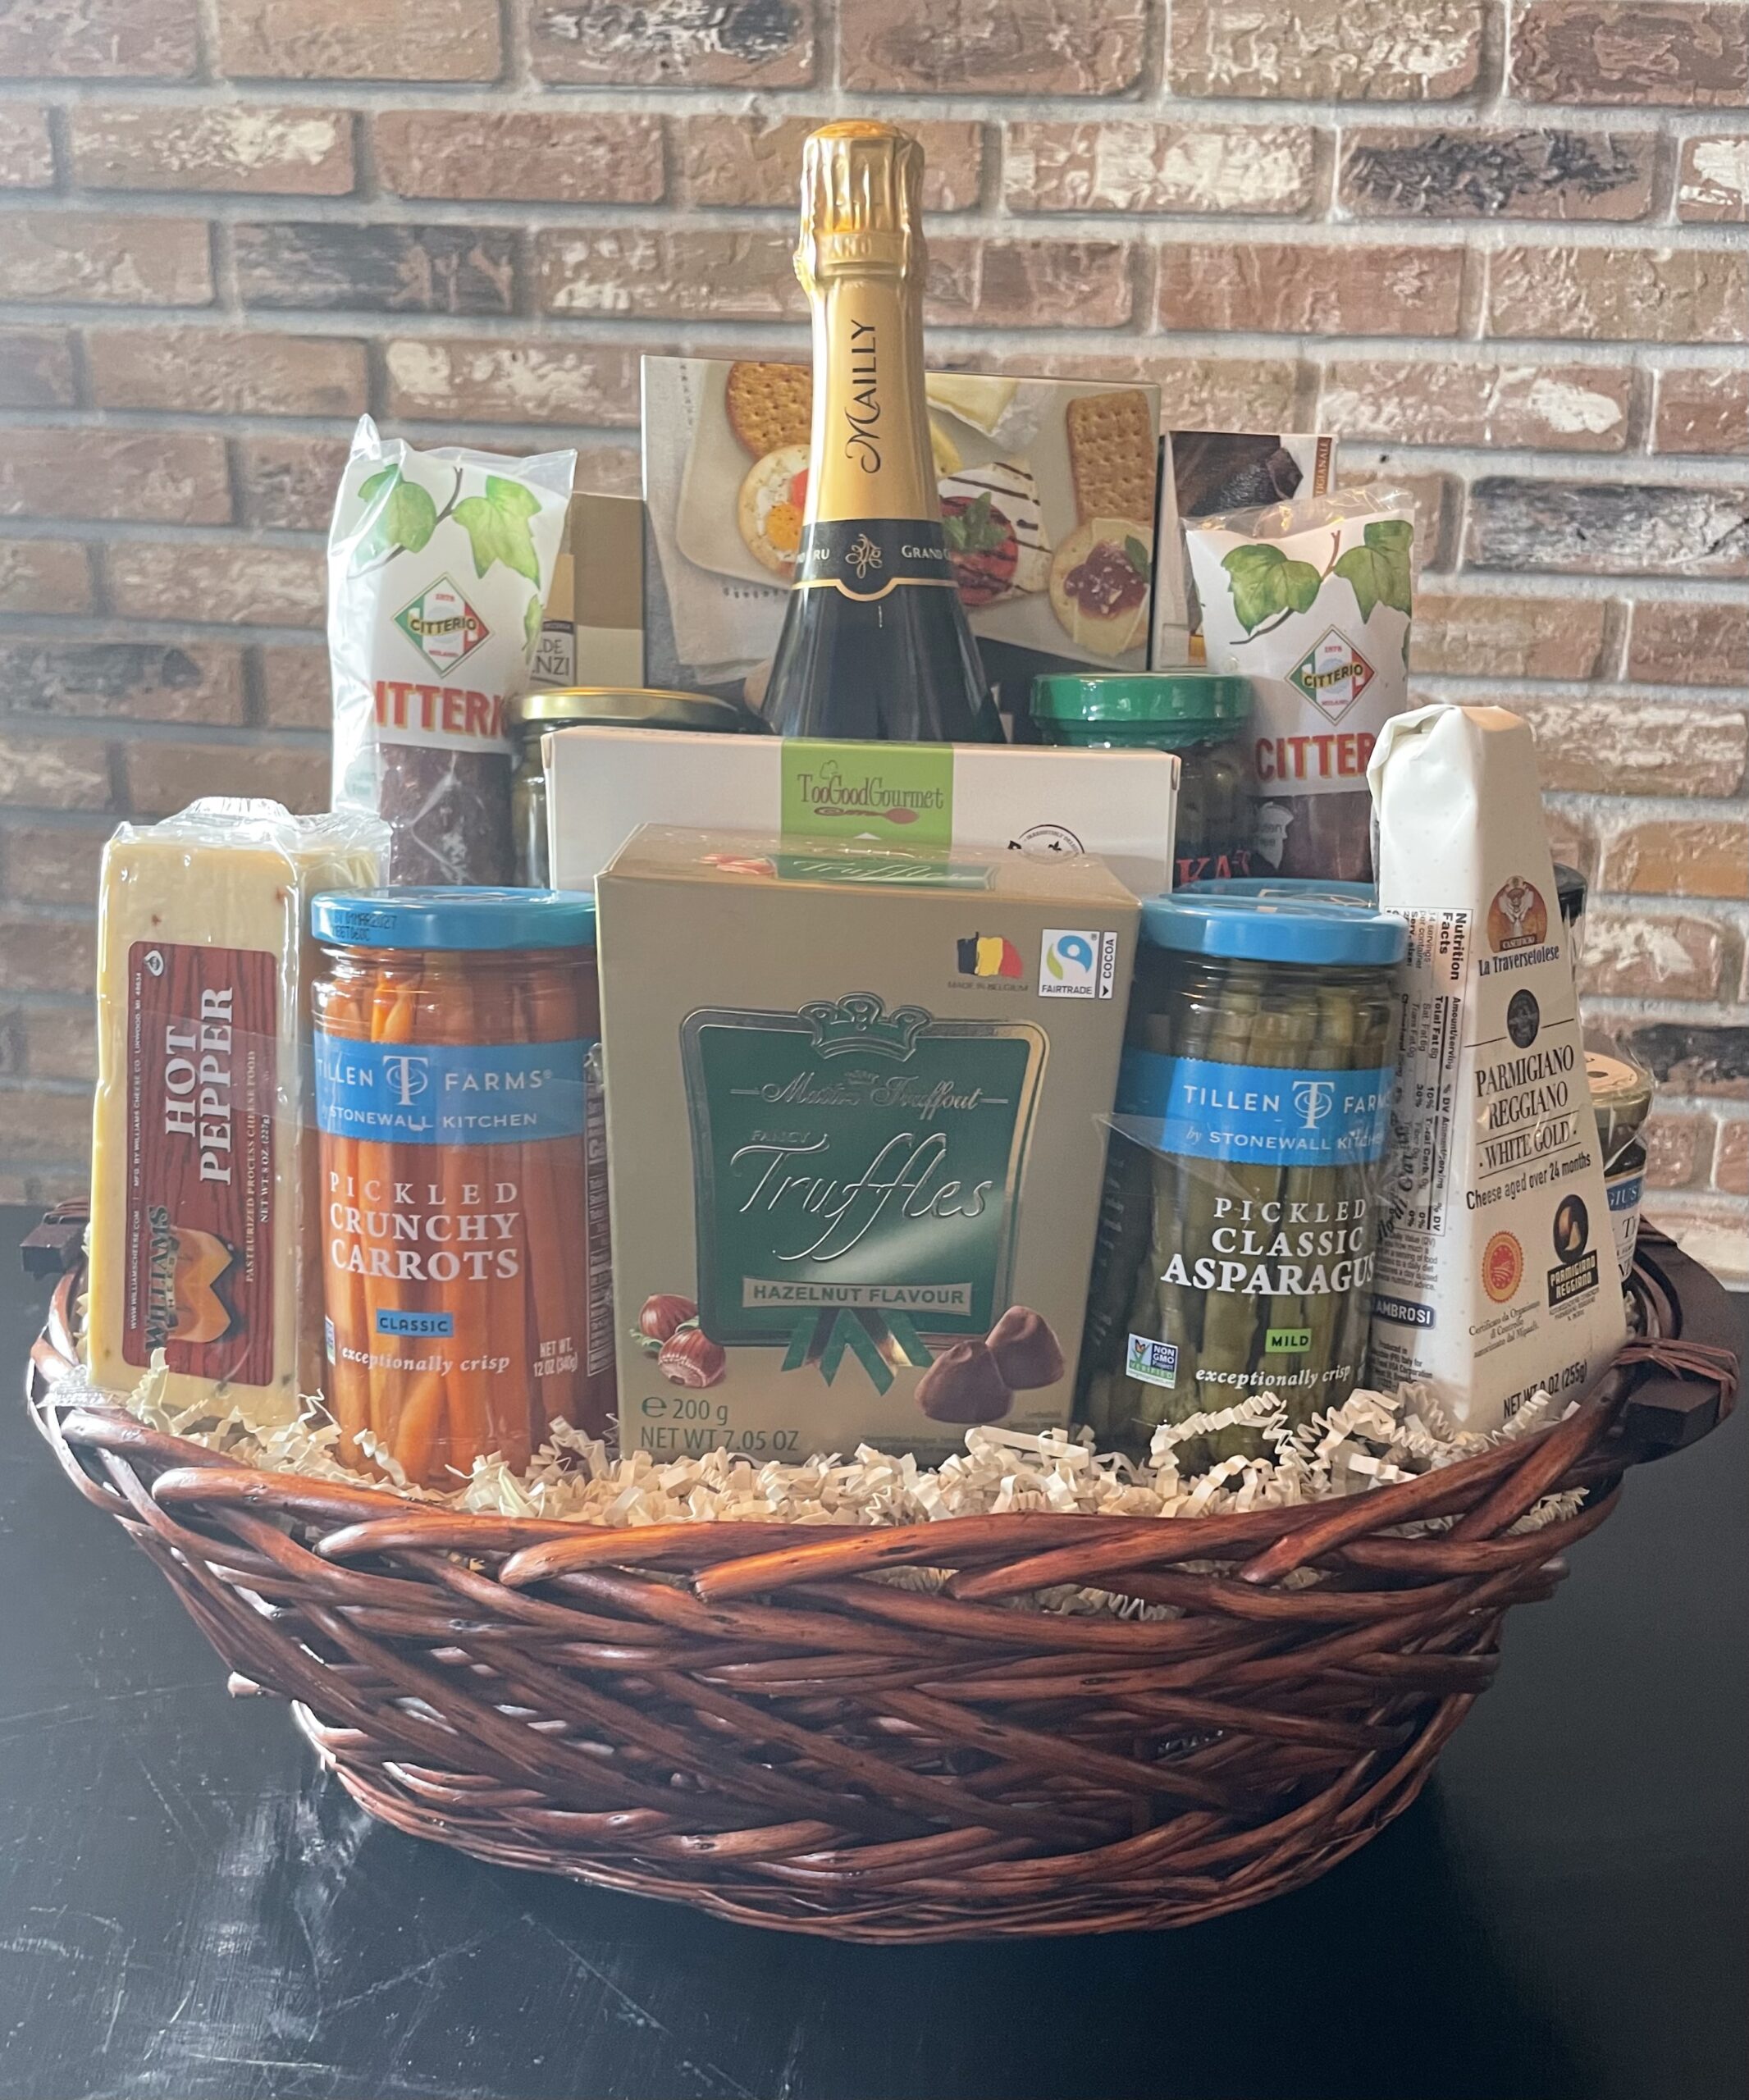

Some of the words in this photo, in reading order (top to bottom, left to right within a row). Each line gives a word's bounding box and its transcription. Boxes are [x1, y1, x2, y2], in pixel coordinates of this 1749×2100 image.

[845, 320, 880, 473] MAILLY
[902, 545, 943, 560] GRAND
[410, 617, 477, 635] CITTERIO
[532, 655, 570, 677] NZI
[1304, 664, 1363, 688] CITTERIO
[374, 680, 506, 737] ITTERI
[1255, 733, 1377, 783] CITTER
[797, 773, 944, 810] TooGoodGourmet
[1423, 924, 1435, 963] servings
[1439, 911, 1453, 955] Facts
[1450, 912, 1468, 981] Nutrition
[1103, 939, 1114, 979] COCOA
[1478, 959, 1491, 976] La
[1493, 945, 1559, 974] Traversetolese
[1041, 984, 1093, 995] FAIRTRADE
[1432, 996, 1444, 1024] Total
[1432, 1027, 1442, 1045] Fat
[165, 1025, 197, 1138] HOT
[245, 1050, 257, 1086] FOOD
[317, 1058, 373, 1087] TILLEN
[1475, 1044, 1574, 1098] PARMIGIANO
[199, 987, 233, 1186] PEPPER
[1183, 1084, 1280, 1112] TILLEN
[1426, 1086, 1435, 1109] 10%
[329, 1106, 434, 1131] STONEWALL
[443, 1112, 538, 1129] KITCHEN
[1441, 1097, 1451, 1113] DV
[1489, 1080, 1569, 1130] REGGIANO
[751, 1130, 811, 1144] FANCY
[1209, 1130, 1331, 1151] STONEWALL
[1485, 1132, 1532, 1170] WHITE
[1533, 1121, 1571, 1153] GOLD
[133, 1152, 140, 1165] BY
[245, 1139, 257, 1195] PROCESS
[330, 1171, 518, 1206] PICKLED
[1466, 1186, 1502, 1210] Cheese
[1505, 1171, 1527, 1200] aged
[1529, 1170, 1547, 1189] over
[1550, 1160, 1561, 1181] 24
[1561, 1151, 1591, 1176] months
[730, 1132, 994, 1262] Truffles
[1213, 1198, 1368, 1223] PICKLED
[260, 1200, 269, 1223] NET
[330, 1202, 520, 1242] CRUNCHY
[1432, 1215, 1442, 1231] DV
[245, 1197, 256, 1283] PASTEURIZED
[1212, 1226, 1363, 1257] CLASSIC
[331, 1239, 519, 1281] CARROTS
[1550, 1255, 1596, 1287] PARMIGIANO
[144, 1204, 171, 1353] WILLIAMS
[1160, 1253, 1375, 1296] ASPARAGUS
[1556, 1271, 1592, 1299] REGGIANO
[753, 1285, 863, 1303] HAZELNUT
[870, 1288, 964, 1305] FLAVOUR
[379, 1316, 450, 1333] CLASSIC
[1376, 1299, 1431, 1325] AMBROSI
[539, 1340, 557, 1358] NET
[1153, 1344, 1175, 1357] NON
[1272, 1335, 1308, 1348] MILD
[342, 1346, 454, 1377] exceptionally
[460, 1355, 510, 1375] crisp
[533, 1361, 544, 1377] 12
[545, 1358, 555, 1375] OZ
[1130, 1362, 1173, 1379] VERIFIED
[1153, 1353, 1175, 1364] GMO
[1195, 1367, 1317, 1389] exceptionally
[1322, 1364, 1351, 1384] crisp
[1503, 1392, 1522, 1419] NET
[1548, 1372, 1559, 1395] OZ
[1561, 1358, 1587, 1391] (255g)
[673, 1399, 710, 1420] 200
[717, 1404, 728, 1426] g
[641, 1427, 679, 1449] NET
[683, 1427, 719, 1449] WT
[723, 1429, 766, 1451] 7.05
[773, 1430, 800, 1451] OZ
